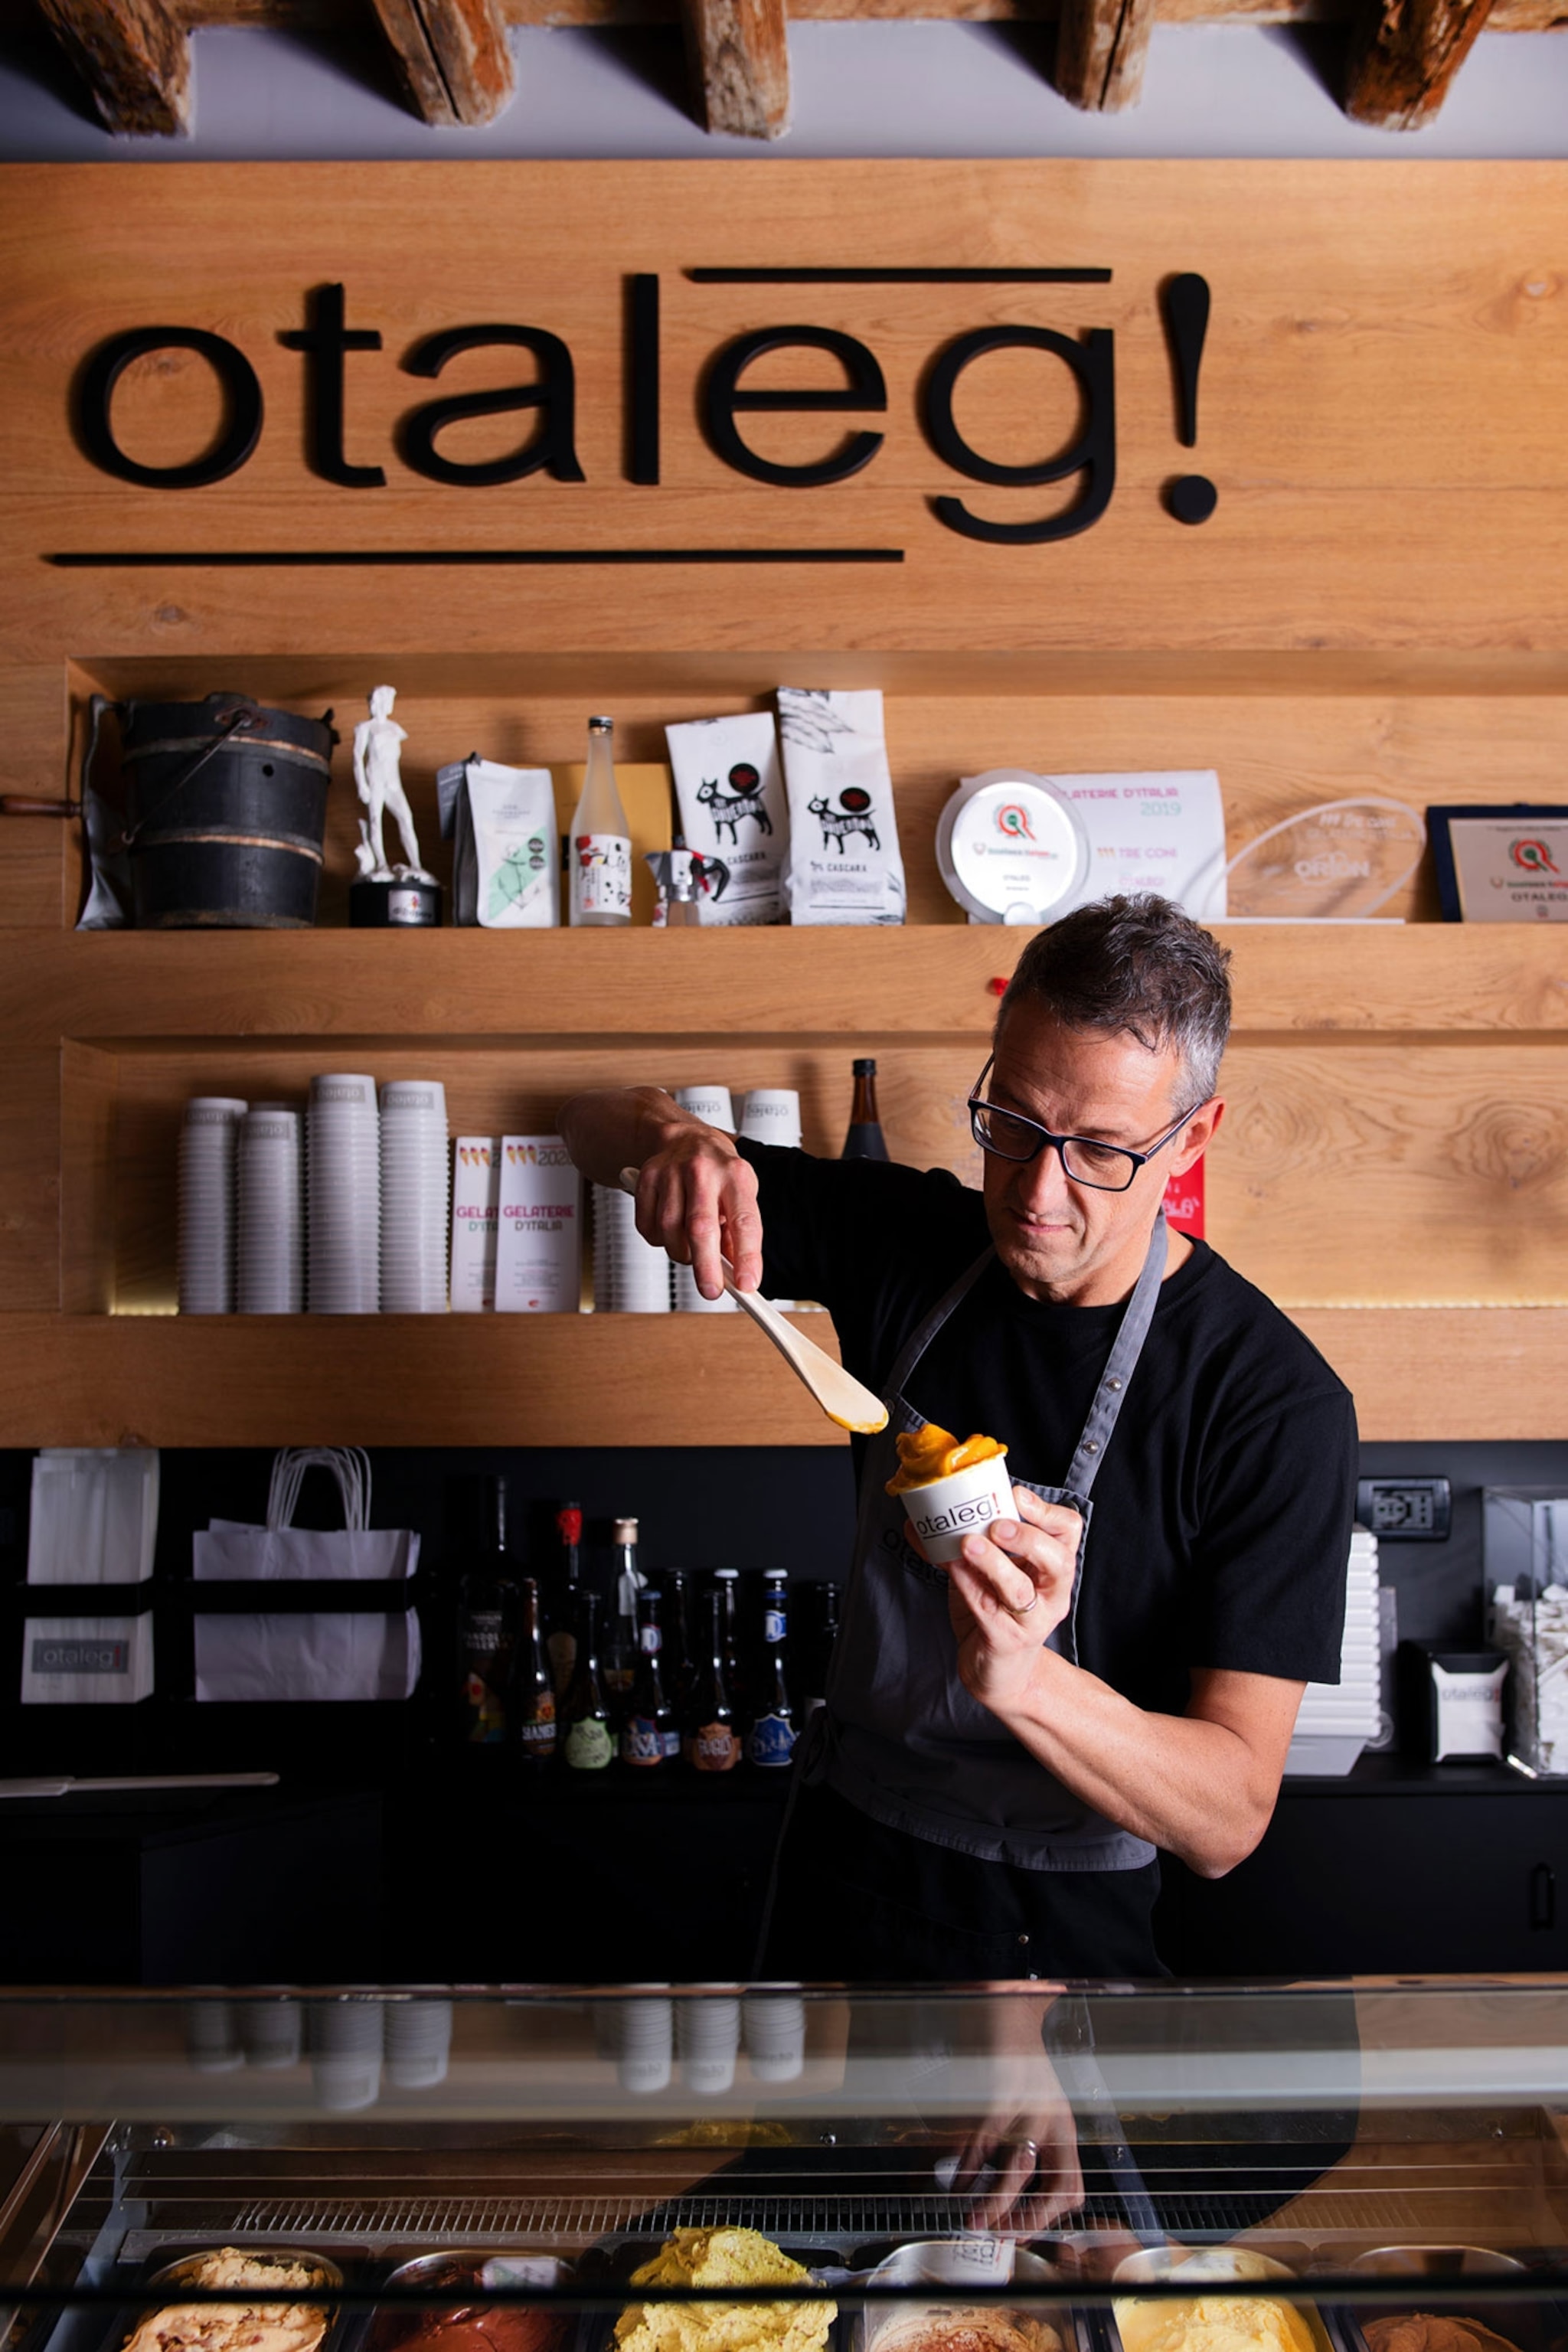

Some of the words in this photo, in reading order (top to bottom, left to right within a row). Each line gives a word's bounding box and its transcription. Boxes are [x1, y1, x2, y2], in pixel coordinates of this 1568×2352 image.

[68, 271, 1219, 545] otaleg!
[1140, 801, 1183, 817] 2019
[1119, 847, 1139, 858] TRE
[1144, 847, 1177, 858] CONI
[827, 862, 867, 873] CASCARA
[1293, 855, 1370, 878] ORION
[538, 1151, 573, 1167] 202
[456, 1205, 498, 1218] GELAT
[503, 1204, 575, 1218] GELATERIE
[514, 1220, 564, 1232] D'ITALIA
[916, 1492, 1002, 1536] otaleg!
[43, 1645, 121, 1671] otaleg!
